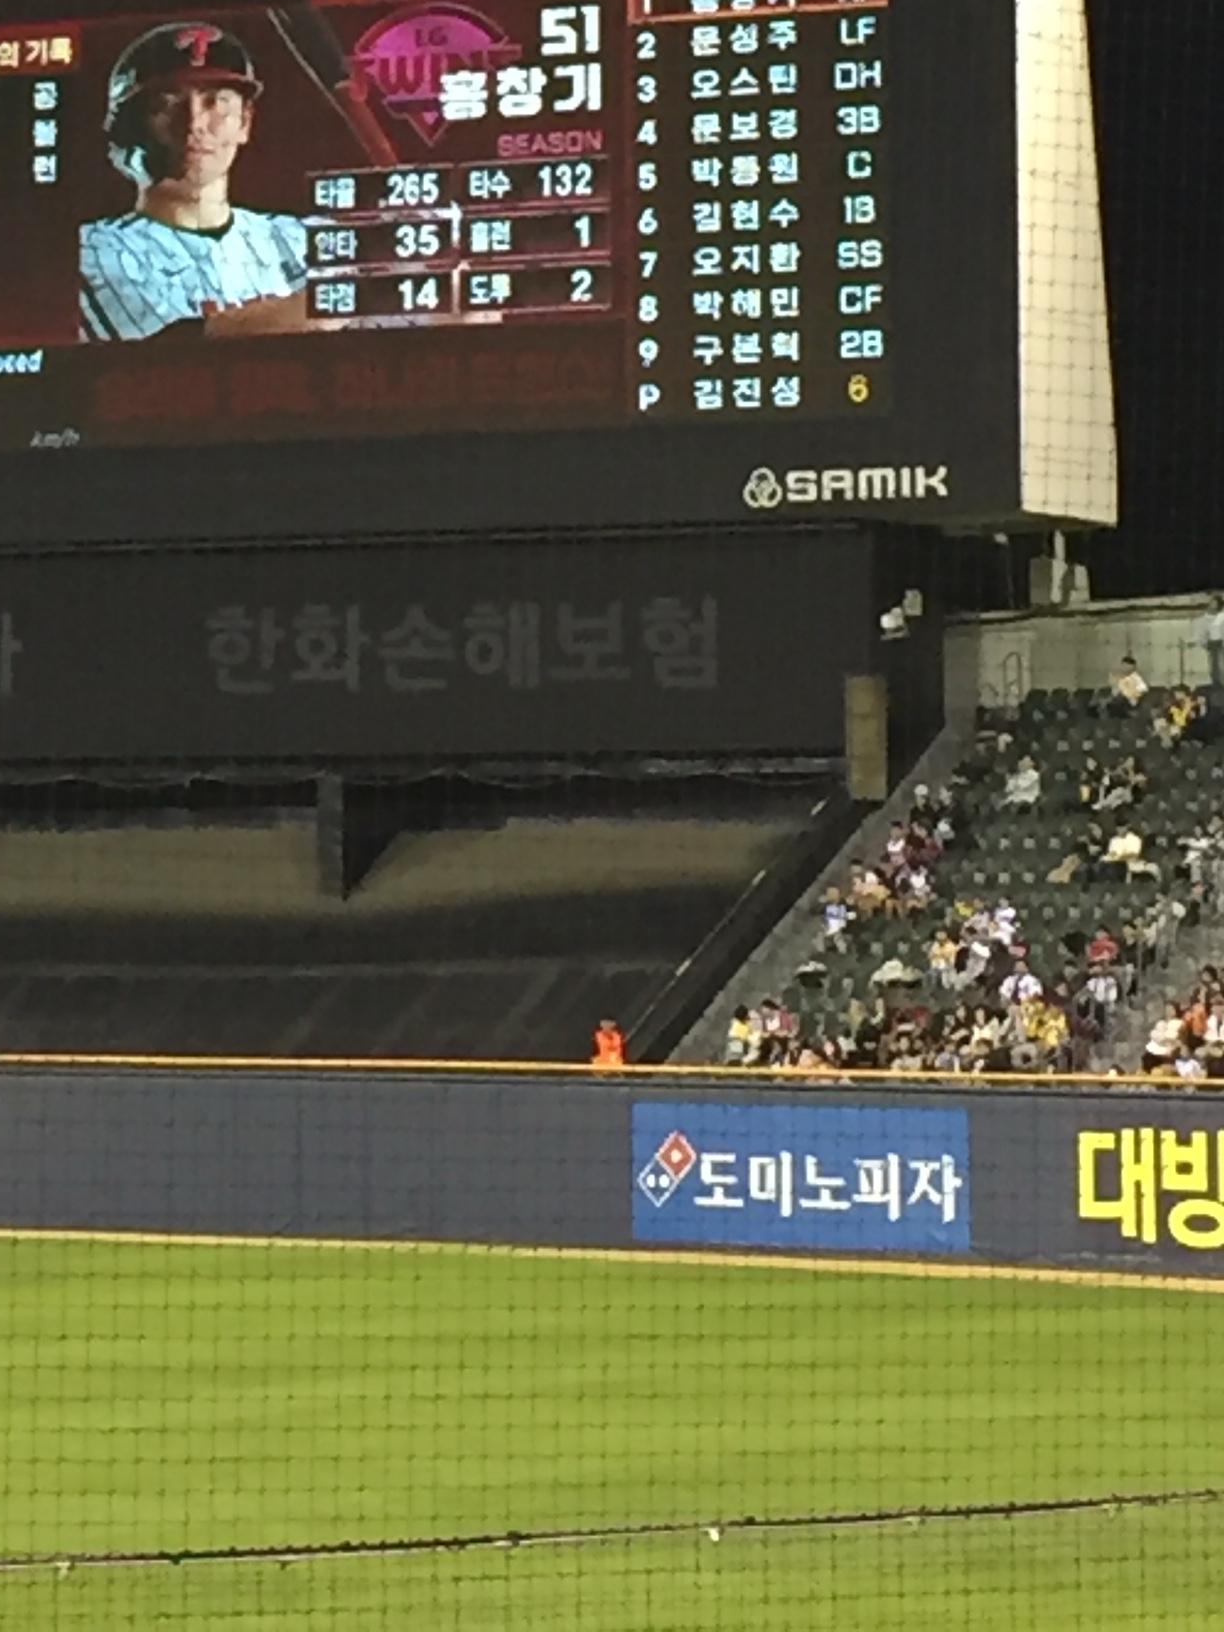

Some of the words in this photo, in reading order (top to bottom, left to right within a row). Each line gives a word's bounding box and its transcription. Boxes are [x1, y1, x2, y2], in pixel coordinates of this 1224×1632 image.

[25, 37, 73, 65] 기록
[540, 5, 600, 57] 51
[636, 31, 656, 60] 2
[690, 20, 797, 57] 문성주
[840, 16, 876, 46] LF
[439, 62, 603, 121] 홍창기
[637, 75, 658, 104] 3
[690, 64, 798, 100] 오스틴
[834, 60, 882, 91] DH
[496, 130, 604, 157] SEASON
[636, 119, 658, 146] 4
[691, 109, 798, 144] 문보경
[836, 105, 881, 135] 3B
[378, 172, 440, 210] .265
[469, 169, 512, 199] 타수
[538, 162, 593, 197] 132
[638, 162, 658, 191] 5
[691, 152, 799, 187] 박동원
[847, 150, 872, 179] C
[637, 207, 658, 235] 6
[692, 198, 800, 233] 김현수
[843, 195, 876, 224] 1B
[314, 229, 358, 262] 안타
[395, 224, 440, 258] 35
[470, 220, 511, 253] 홈런
[574, 215, 591, 248] 1
[638, 251, 658, 278] 7
[692, 242, 801, 276] 오지환
[838, 239, 883, 269] SS
[315, 283, 356, 314] 타점
[398, 278, 439, 311] 14
[469, 273, 511, 305] 도루
[570, 269, 593, 303] 2
[638, 295, 659, 323] 8
[693, 286, 800, 320] 박해민
[839, 284, 883, 315] CF
[638, 339, 659, 367] 9
[693, 331, 800, 366] 구본혁
[840, 329, 884, 359] 2B
[638, 384, 661, 411] P
[693, 376, 801, 410] 김진성
[848, 374, 869, 403] 6
[785, 465, 948, 502] SAMIK
[204, 594, 720, 694] 한화손해보험
[693, 1151, 963, 1224] 도미노피자
